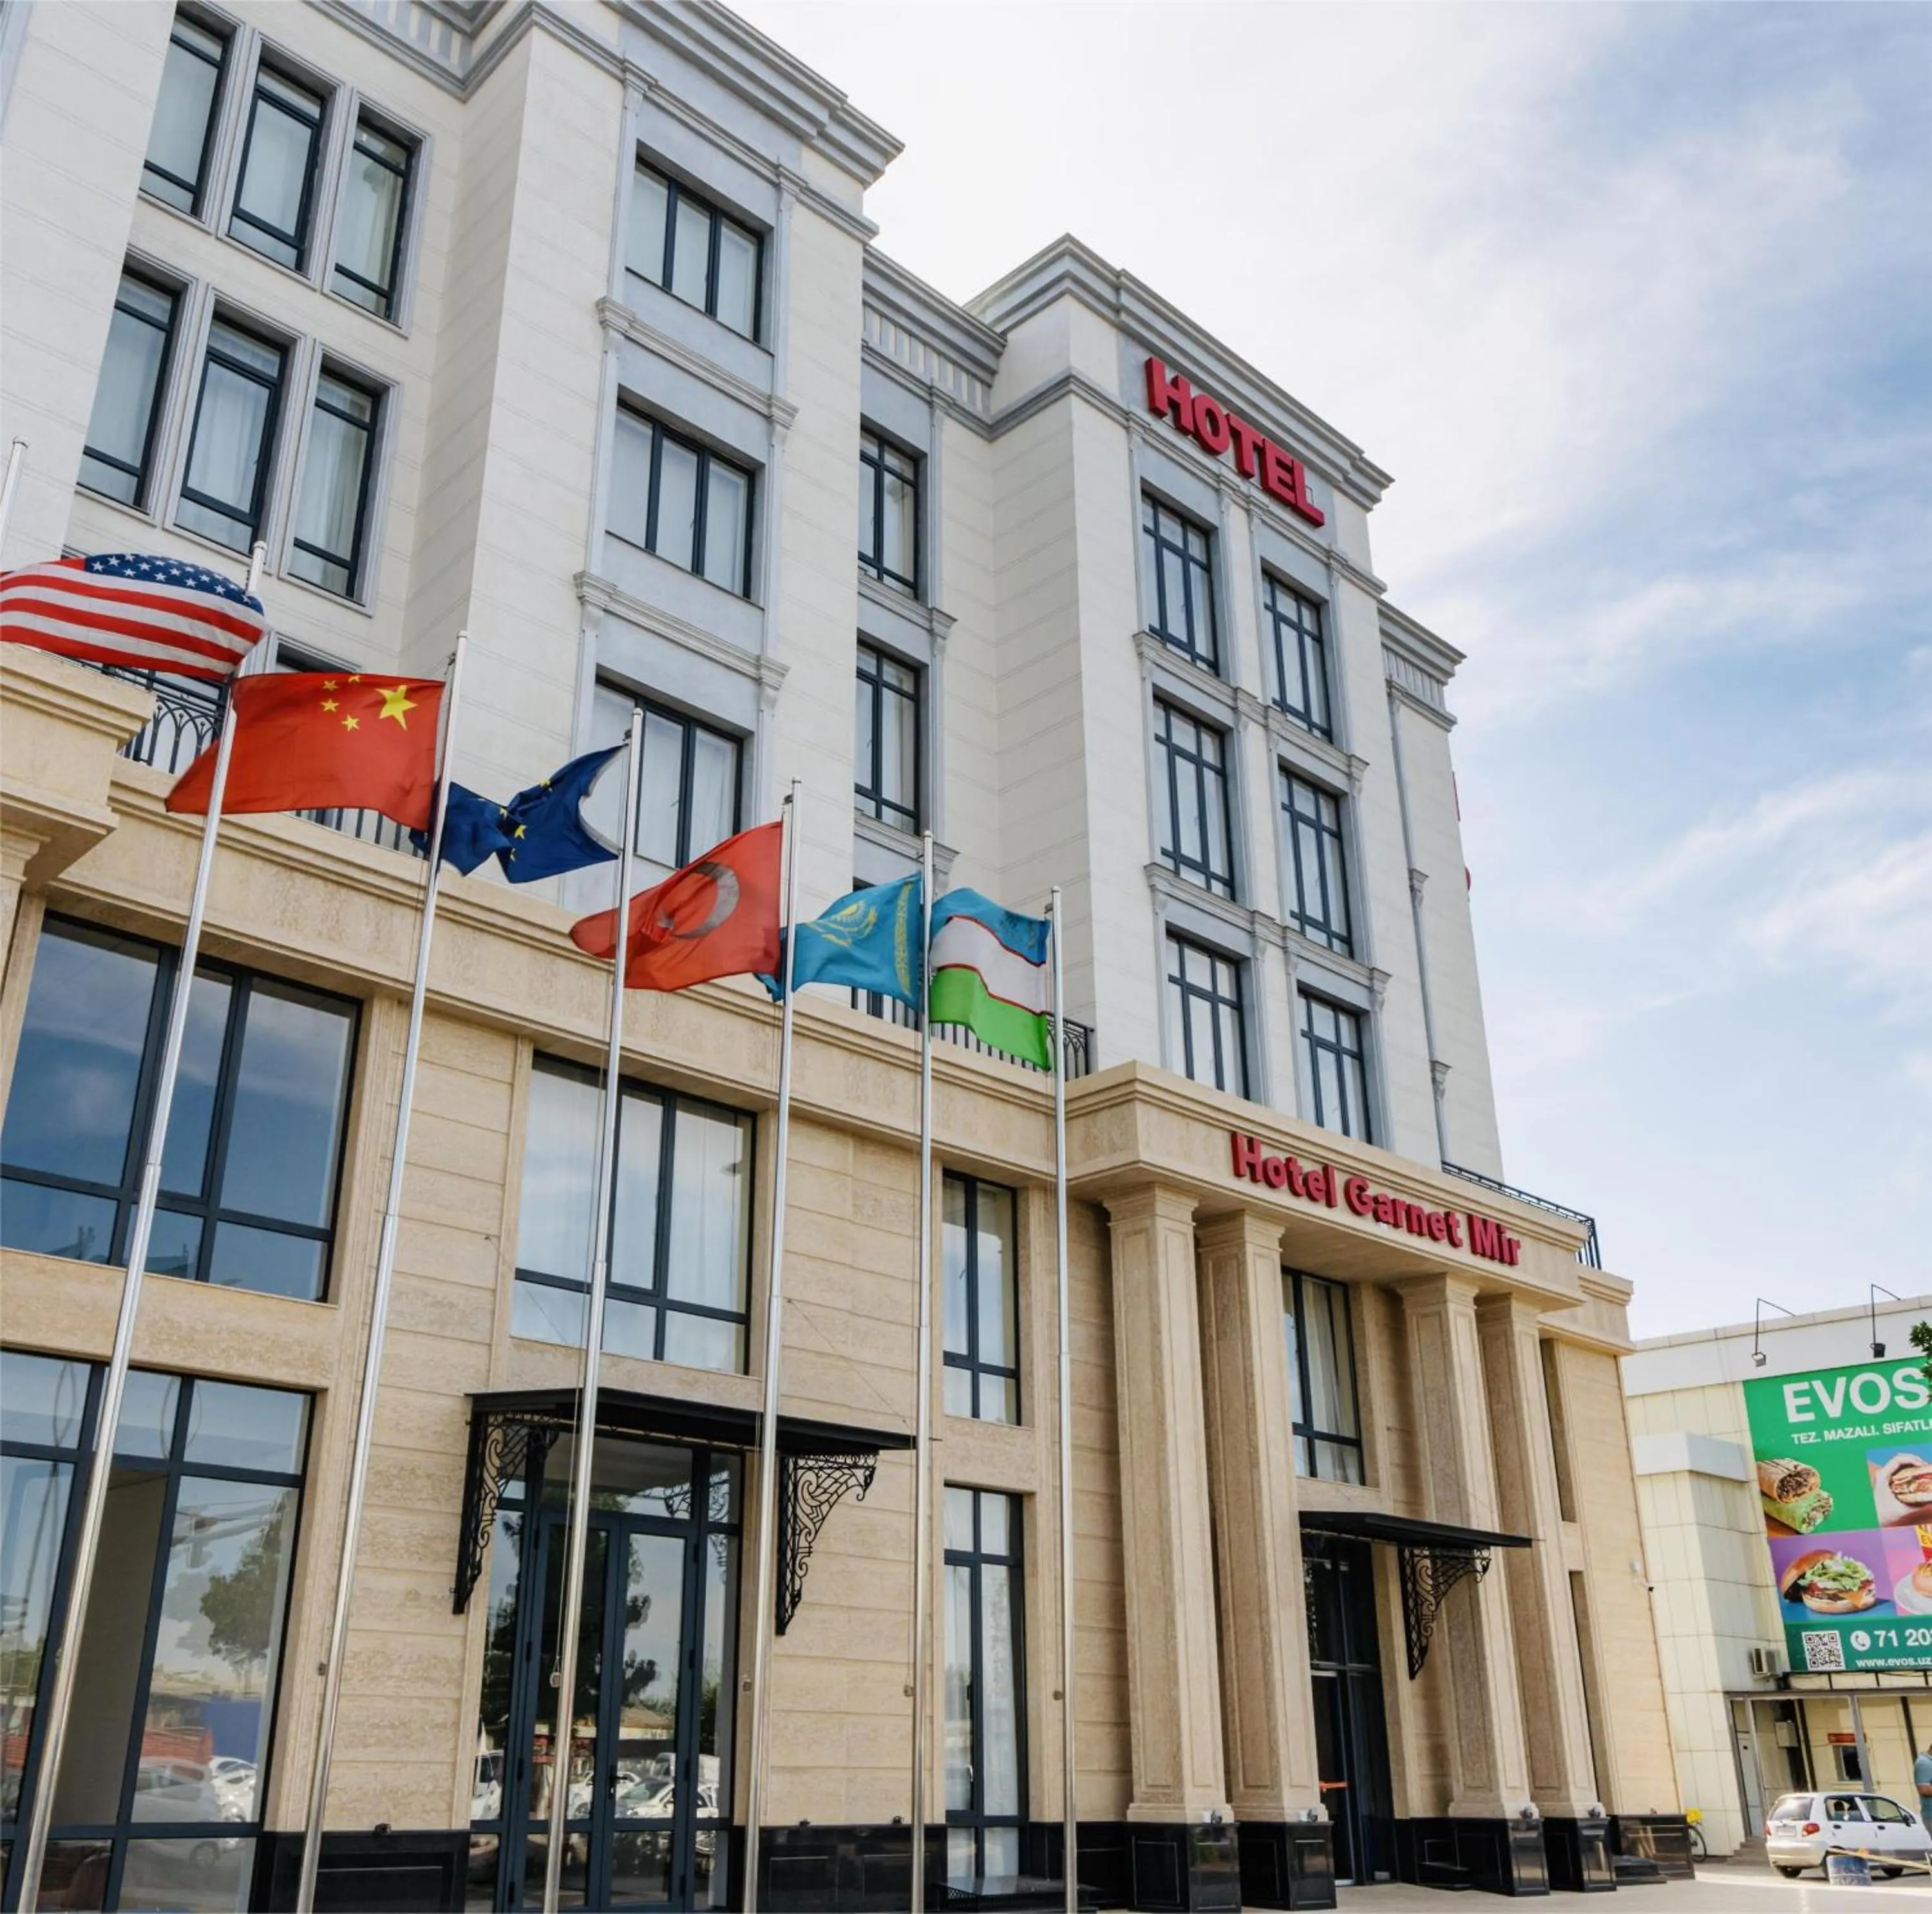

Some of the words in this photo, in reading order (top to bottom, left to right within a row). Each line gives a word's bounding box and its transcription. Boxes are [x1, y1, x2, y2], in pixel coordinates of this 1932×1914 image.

[1145, 356, 1325, 527] HOTEL
[1231, 1132, 1338, 1208] Hotel
[1344, 1175, 1463, 1248] Garnet
[1468, 1213, 1520, 1266] Mir
[1783, 1367, 1929, 1423] EVOS
[1791, 1431, 1821, 1445] TEZ.
[1823, 1425, 1879, 1442] MAZALI.
[1873, 1629, 1899, 1647] 71
[1904, 1627, 1932, 1647] 20
